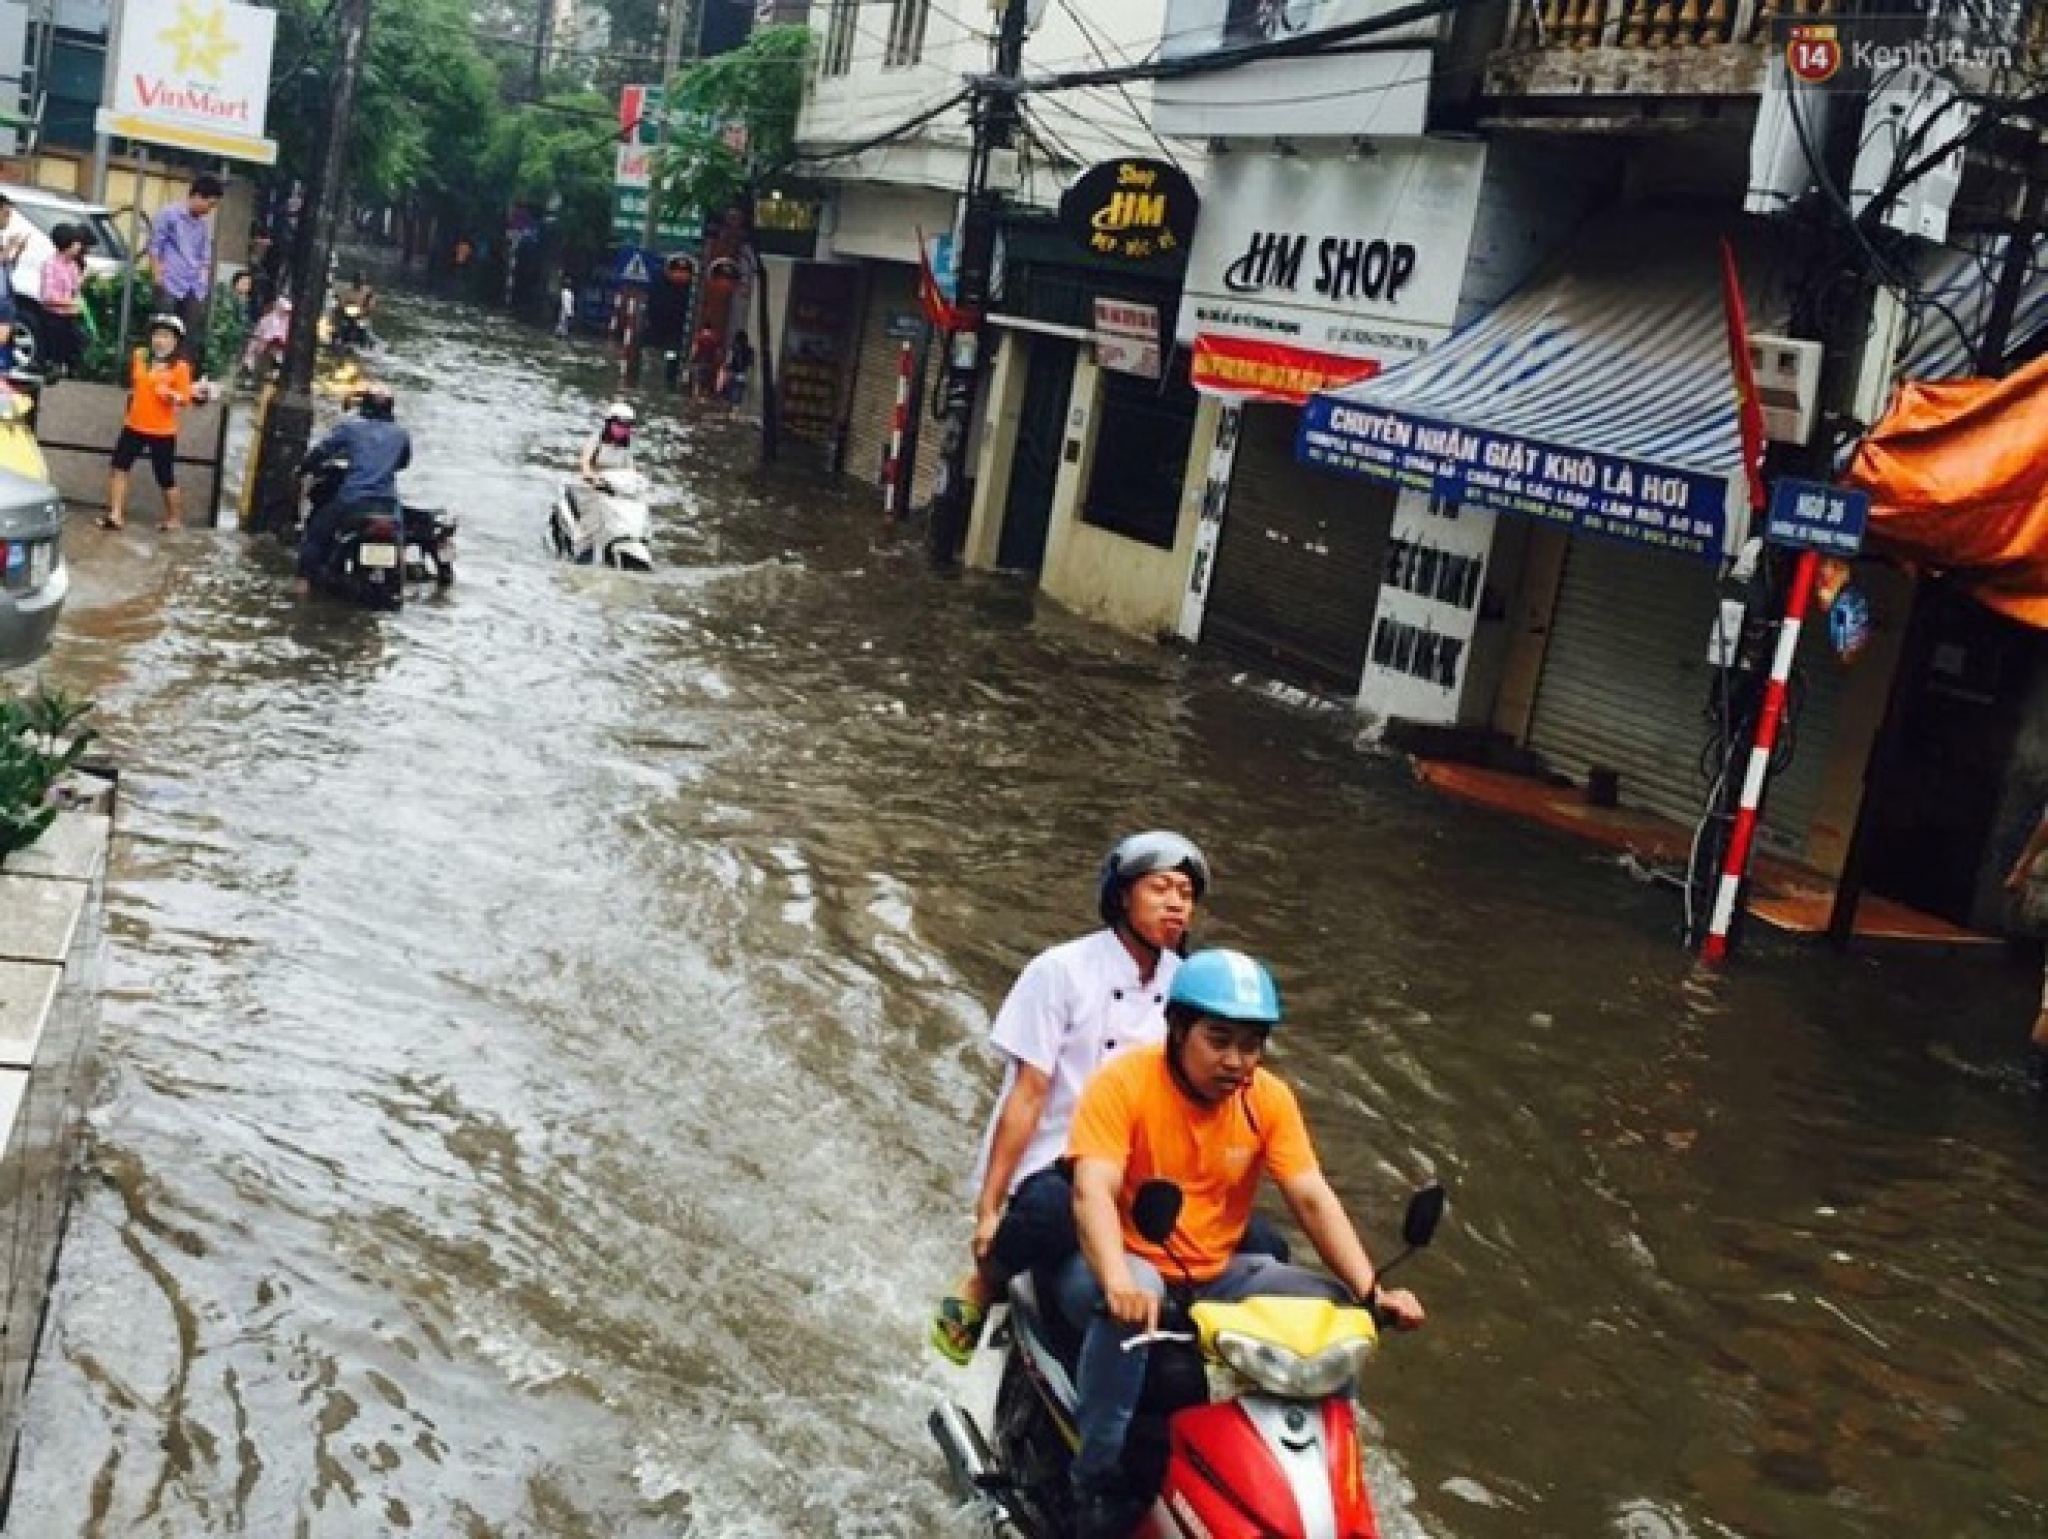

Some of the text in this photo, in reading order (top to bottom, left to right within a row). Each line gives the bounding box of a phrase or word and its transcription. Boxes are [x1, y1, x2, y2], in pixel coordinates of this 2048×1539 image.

[133, 73, 249, 121] VinMart
[1091, 191, 1167, 231] HM
[1223, 231, 1416, 304] HM SHOP
[1329, 406, 1413, 447] CHUYÊN
[1415, 426, 1480, 463] NHẬN
[1542, 453, 1597, 488] KHÔ
[1602, 463, 1634, 497] LÀ
